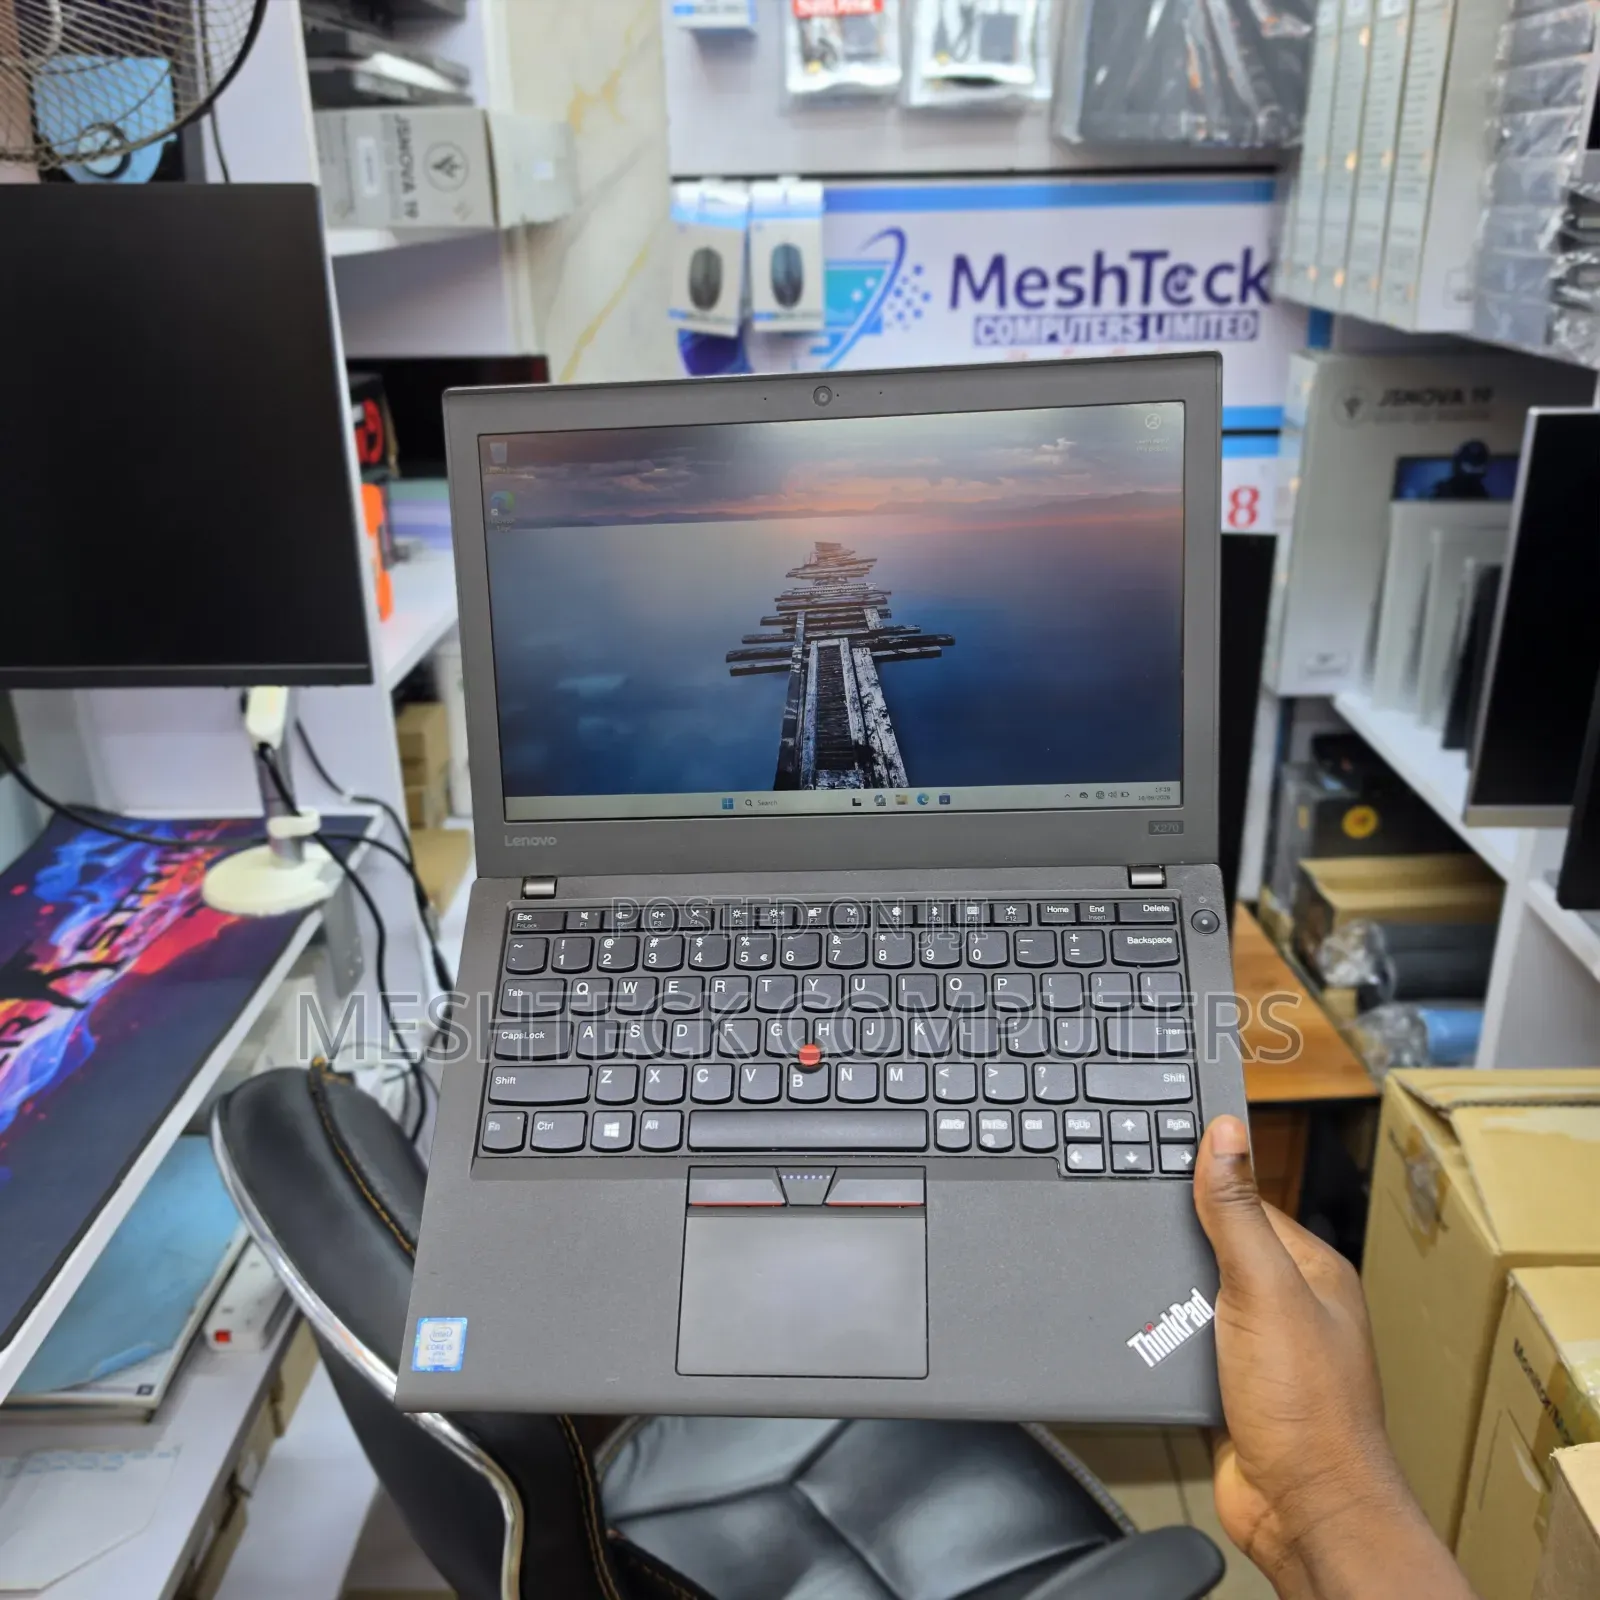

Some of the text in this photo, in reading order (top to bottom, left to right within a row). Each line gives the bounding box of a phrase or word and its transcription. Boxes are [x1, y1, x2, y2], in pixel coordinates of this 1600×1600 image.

[948, 247, 1273, 311] MeshTeck
[976, 311, 1257, 345] COMPUTERS LIMITED
[1228, 485, 1260, 529] 8
[1153, 823, 1179, 833] X270
[504, 834, 557, 847] Lenovo
[517, 913, 532, 921] Esc
[603, 938, 615, 949] @
[649, 938, 659, 948] #
[695, 937, 703, 947] $
[740, 936, 750, 946] %
[832, 935, 842, 945] &
[1069, 933, 1079, 942] +
[1127, 936, 1172, 945] Backspace
[558, 954, 565, 965] 1
[602, 954, 612, 965] 2
[648, 952, 657, 964] 3
[694, 952, 703, 963] 4
[740, 952, 749, 962] 5
[785, 951, 795, 962] 6
[832, 950, 841, 961] 7
[878, 950, 887, 960] 8
[926, 949, 935, 960] 9
[972, 949, 982, 960] 0
[576, 982, 589, 995] Q
[623, 981, 638, 994] W
[668, 980, 678, 993] E
[714, 980, 726, 992] R
[761, 979, 772, 992] T
[808, 979, 819, 992] Y
[854, 978, 866, 991] U
[950, 978, 962, 991] O
[997, 978, 1008, 990] P
[507, 988, 524, 997] Tab
[583, 1025, 594, 1038] A
[629, 1024, 641, 1038] S
[676, 1024, 688, 1037] D
[771, 1022, 783, 1036] G
[818, 1023, 830, 1036] H
[866, 1022, 875, 1036] J
[914, 1022, 926, 1035] K
[961, 1022, 972, 1035] L
[1155, 1027, 1181, 1035] Enter
[501, 1031, 545, 1040] CapsLock
[494, 1076, 516, 1085] Shift
[601, 1070, 613, 1084] Z
[649, 1069, 661, 1083] X
[696, 1069, 709, 1083] C
[745, 1069, 757, 1082] V
[792, 1074, 804, 1087] B
[841, 1068, 853, 1082] N
[890, 1068, 903, 1082] M
[1163, 1073, 1186, 1082] Shift
[487, 1122, 500, 1131] Fn
[536, 1121, 554, 1130] Ctrl
[645, 1120, 659, 1130] Alt
[1068, 1120, 1090, 1130] PgUp
[1166, 1119, 1190, 1130] PgDn
[1126, 1286, 1214, 1367] ThinkPad
